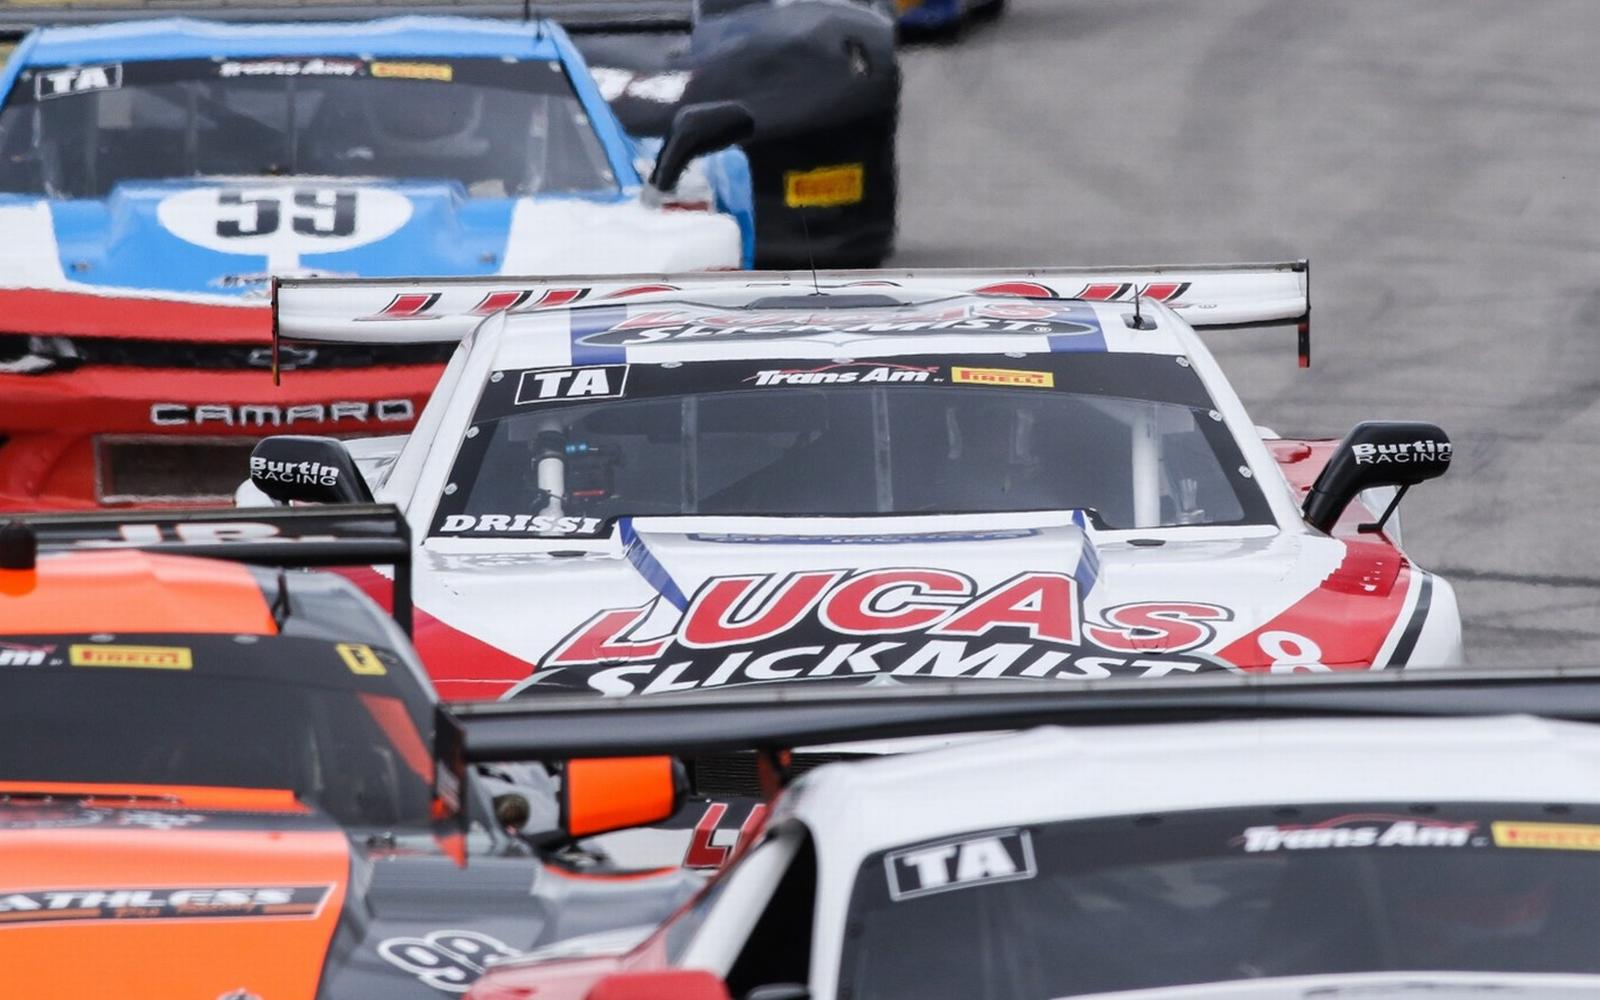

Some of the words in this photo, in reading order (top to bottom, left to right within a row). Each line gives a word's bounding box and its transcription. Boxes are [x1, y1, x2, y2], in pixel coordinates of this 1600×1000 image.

[47, 67, 109, 94] TA
[216, 187, 358, 238] 59
[533, 369, 611, 398] TA
[755, 370, 858, 386] Trans
[859, 367, 930, 383] Am
[150, 400, 414, 427] CAMARO
[1351, 440, 1452, 456] Burtin
[1356, 452, 1452, 465] RACING
[250, 456, 340, 478] Burtin
[250, 469, 337, 486] RACING
[440, 514, 602, 534] DRISSI
[537, 568, 1236, 670] LUCAS
[587, 640, 1202, 698] SLICKMIST
[1244, 826, 1377, 852] Trans
[1377, 821, 1470, 846] Am
[903, 837, 1017, 889] TA
